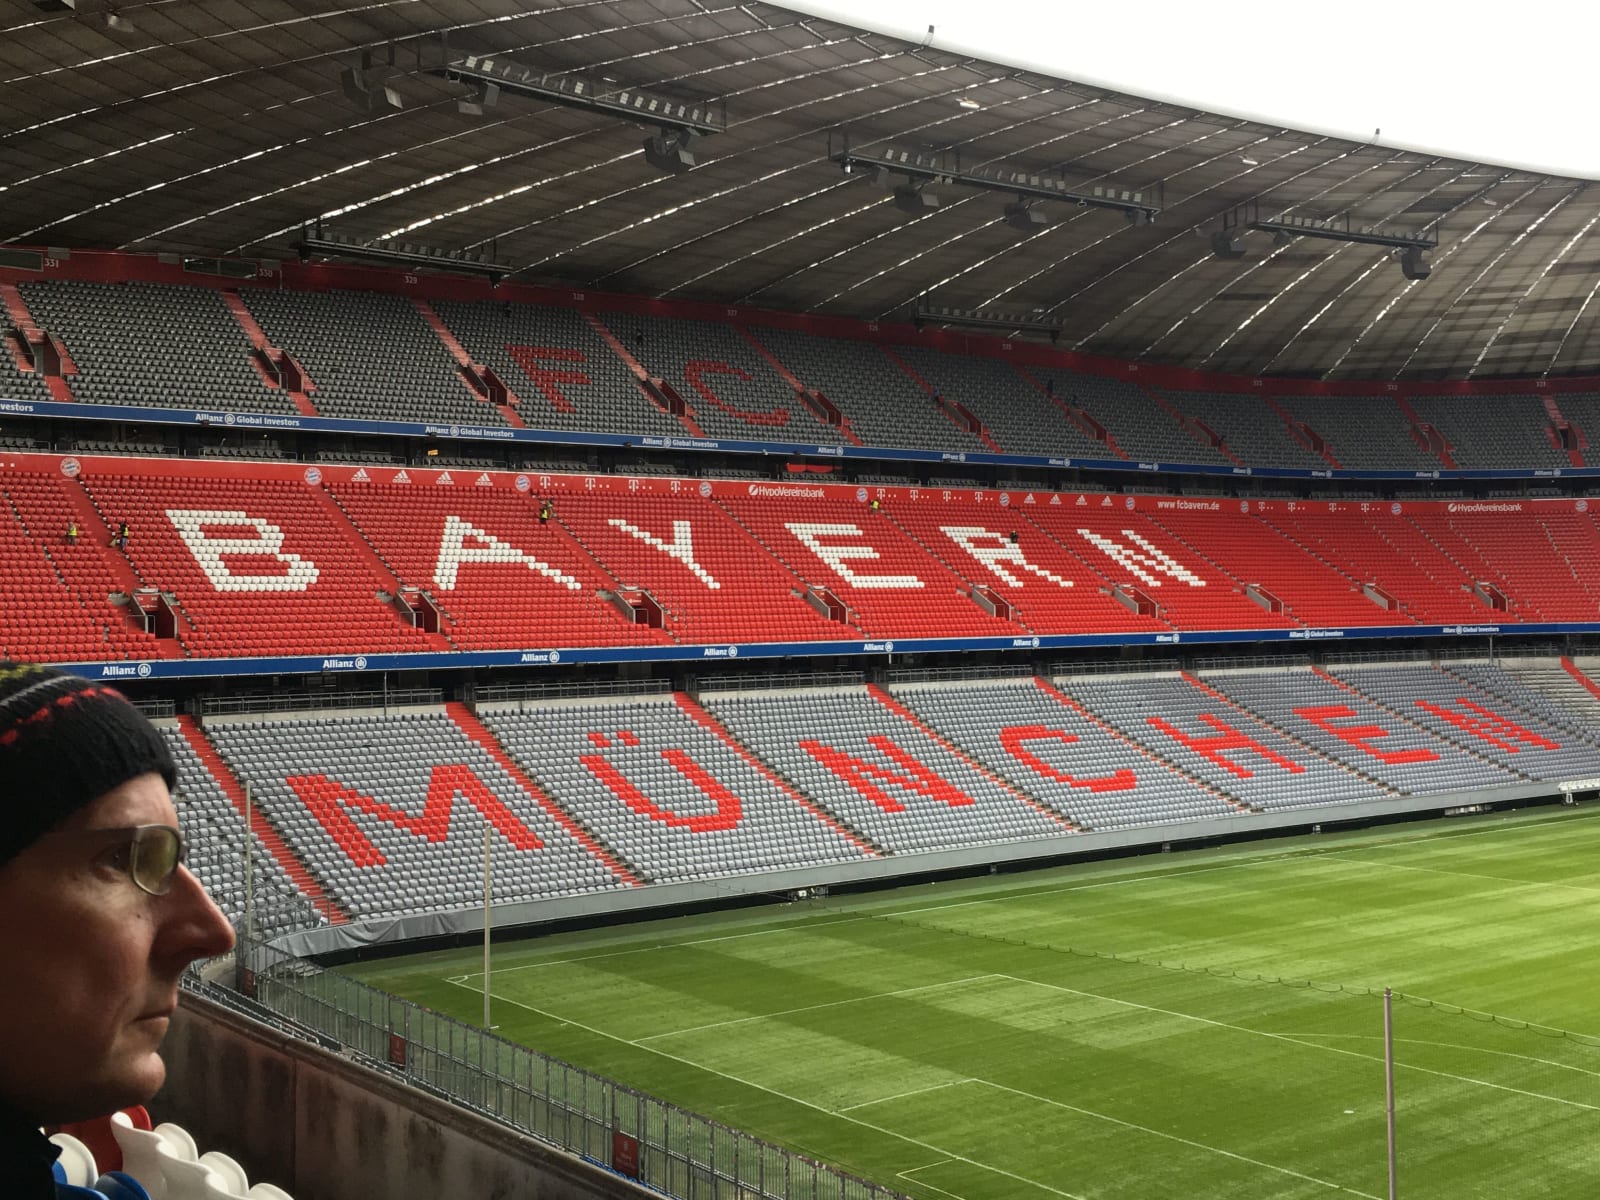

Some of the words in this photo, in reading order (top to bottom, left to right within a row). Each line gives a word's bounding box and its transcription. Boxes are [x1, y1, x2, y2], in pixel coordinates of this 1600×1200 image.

[44, 258, 59, 268] 331
[195, 414, 223, 422] Allianz
[236, 416, 262, 424] Global
[264, 416, 300, 426] Investors
[425, 426, 449, 434] Allianz
[484, 429, 514, 438] Investors
[642, 437, 662, 445] Allianz
[692, 440, 718, 448] Investors
[759, 486, 825, 498] HypoVereinsbank
[1458, 503, 1522, 512] HypoVereinsbank
[165, 509, 1206, 592] BAYERN
[704, 648, 728, 656] Allianz
[864, 643, 884, 651] Allianz
[521, 653, 548, 662] Allianz
[323, 659, 354, 668] Allianz
[102, 665, 136, 675] Allianz
[286, 698, 1561, 868] MÜNCHEN
